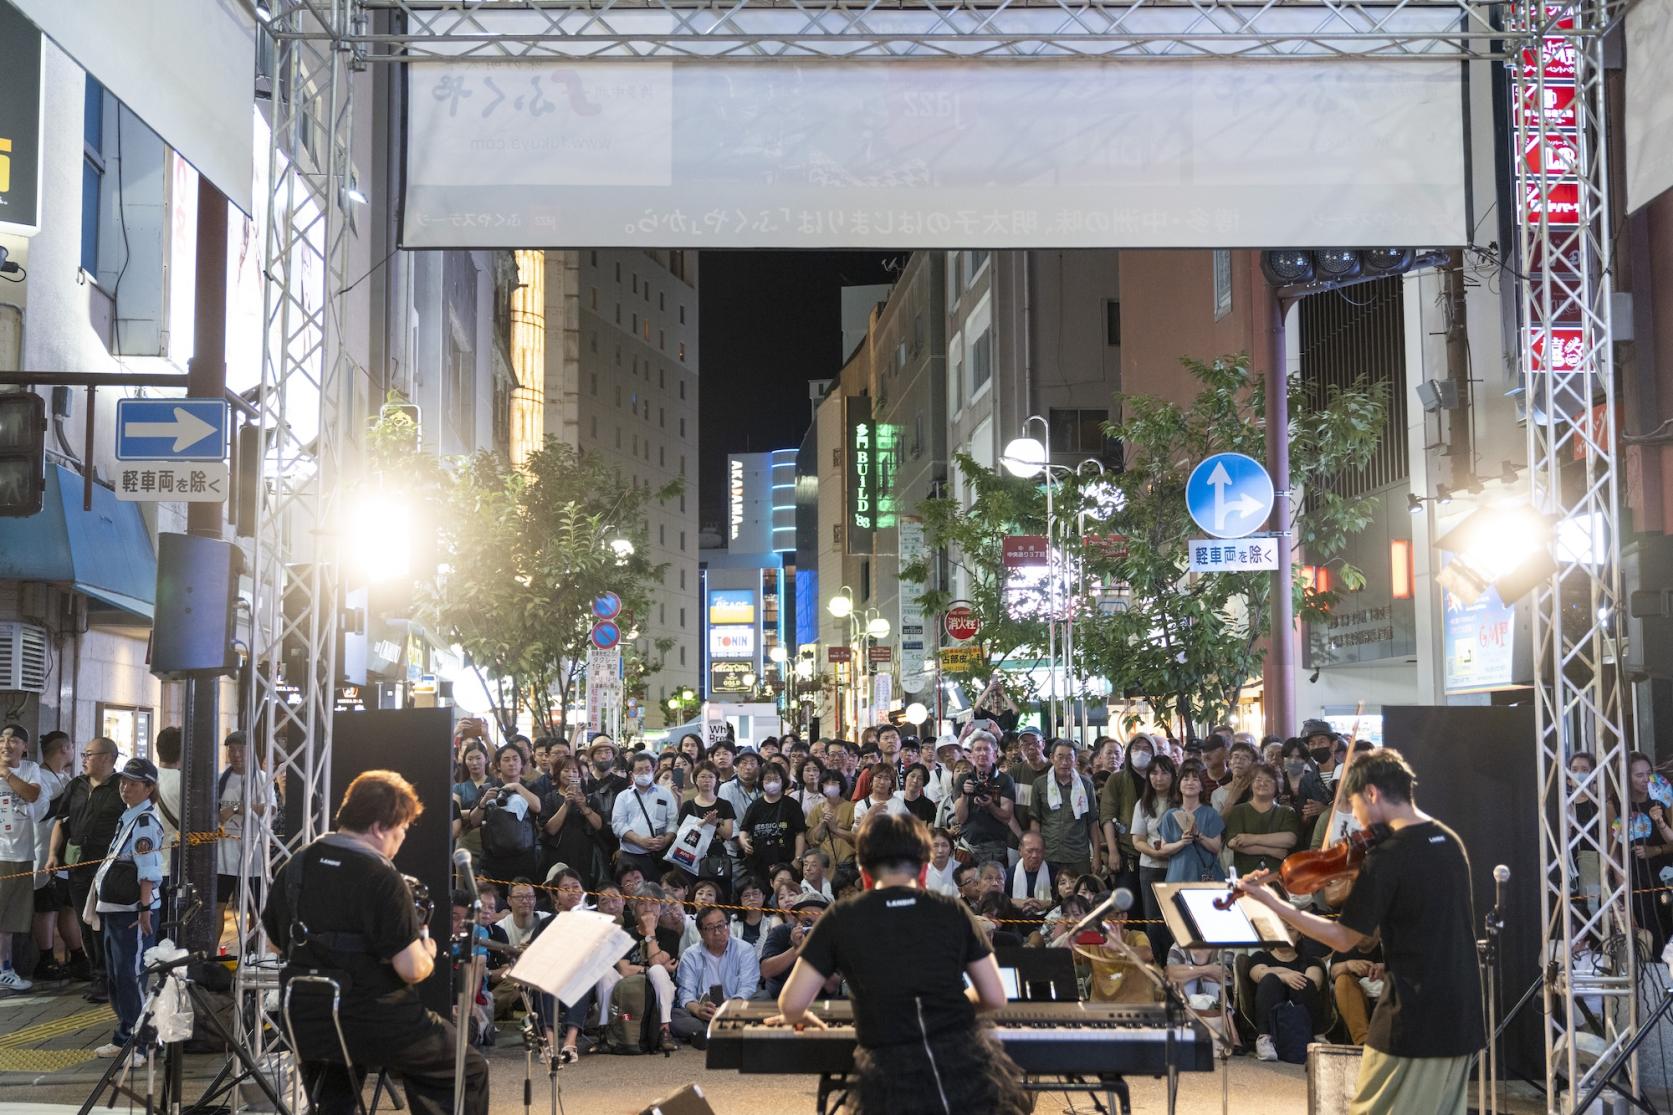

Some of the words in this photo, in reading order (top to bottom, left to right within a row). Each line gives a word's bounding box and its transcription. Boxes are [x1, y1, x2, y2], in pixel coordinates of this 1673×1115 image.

[122, 470, 221, 493] 軽車両を除く
[731, 460, 744, 525] AKADAMA
[1195, 545, 1273, 565] 軽車両を除く
[947, 616, 977, 630] 消火栓
